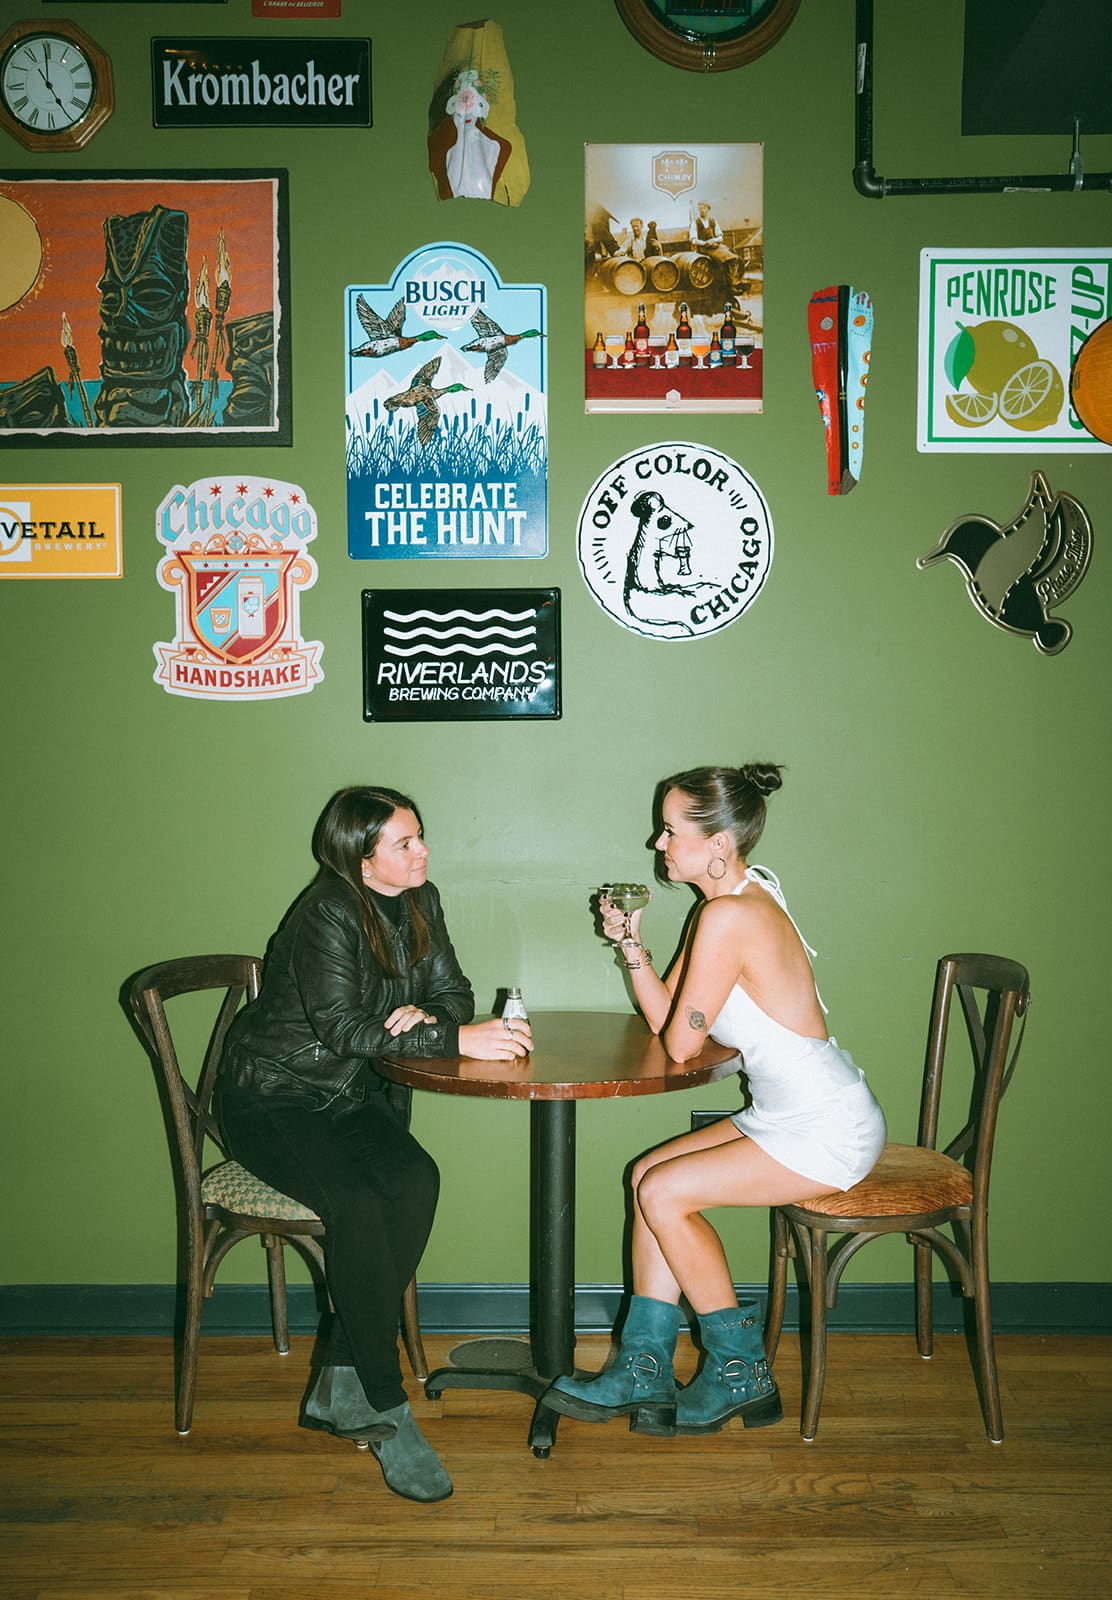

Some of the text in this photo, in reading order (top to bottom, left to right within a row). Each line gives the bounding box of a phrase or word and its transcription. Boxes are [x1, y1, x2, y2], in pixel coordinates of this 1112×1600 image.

[163, 59, 360, 106] Krombacher
[405, 280, 486, 304] BUSCH
[947, 268, 1056, 317] PENROSE
[423, 305, 469, 316] LIGHT
[375, 483, 518, 509] CELEBRATE
[593, 454, 729, 529] OFF COLOR
[161, 489, 312, 543] Chicago
[365, 511, 527, 546] THE HUNT
[35, 542, 102, 551] BREWERY
[690, 517, 762, 625] CHICAGO
[1036, 564, 1074, 603] Phase
[176, 664, 301, 688] HANDSHAKE
[377, 661, 547, 685] RIVERLANDS
[389, 687, 538, 702] BREWING COMPANY
